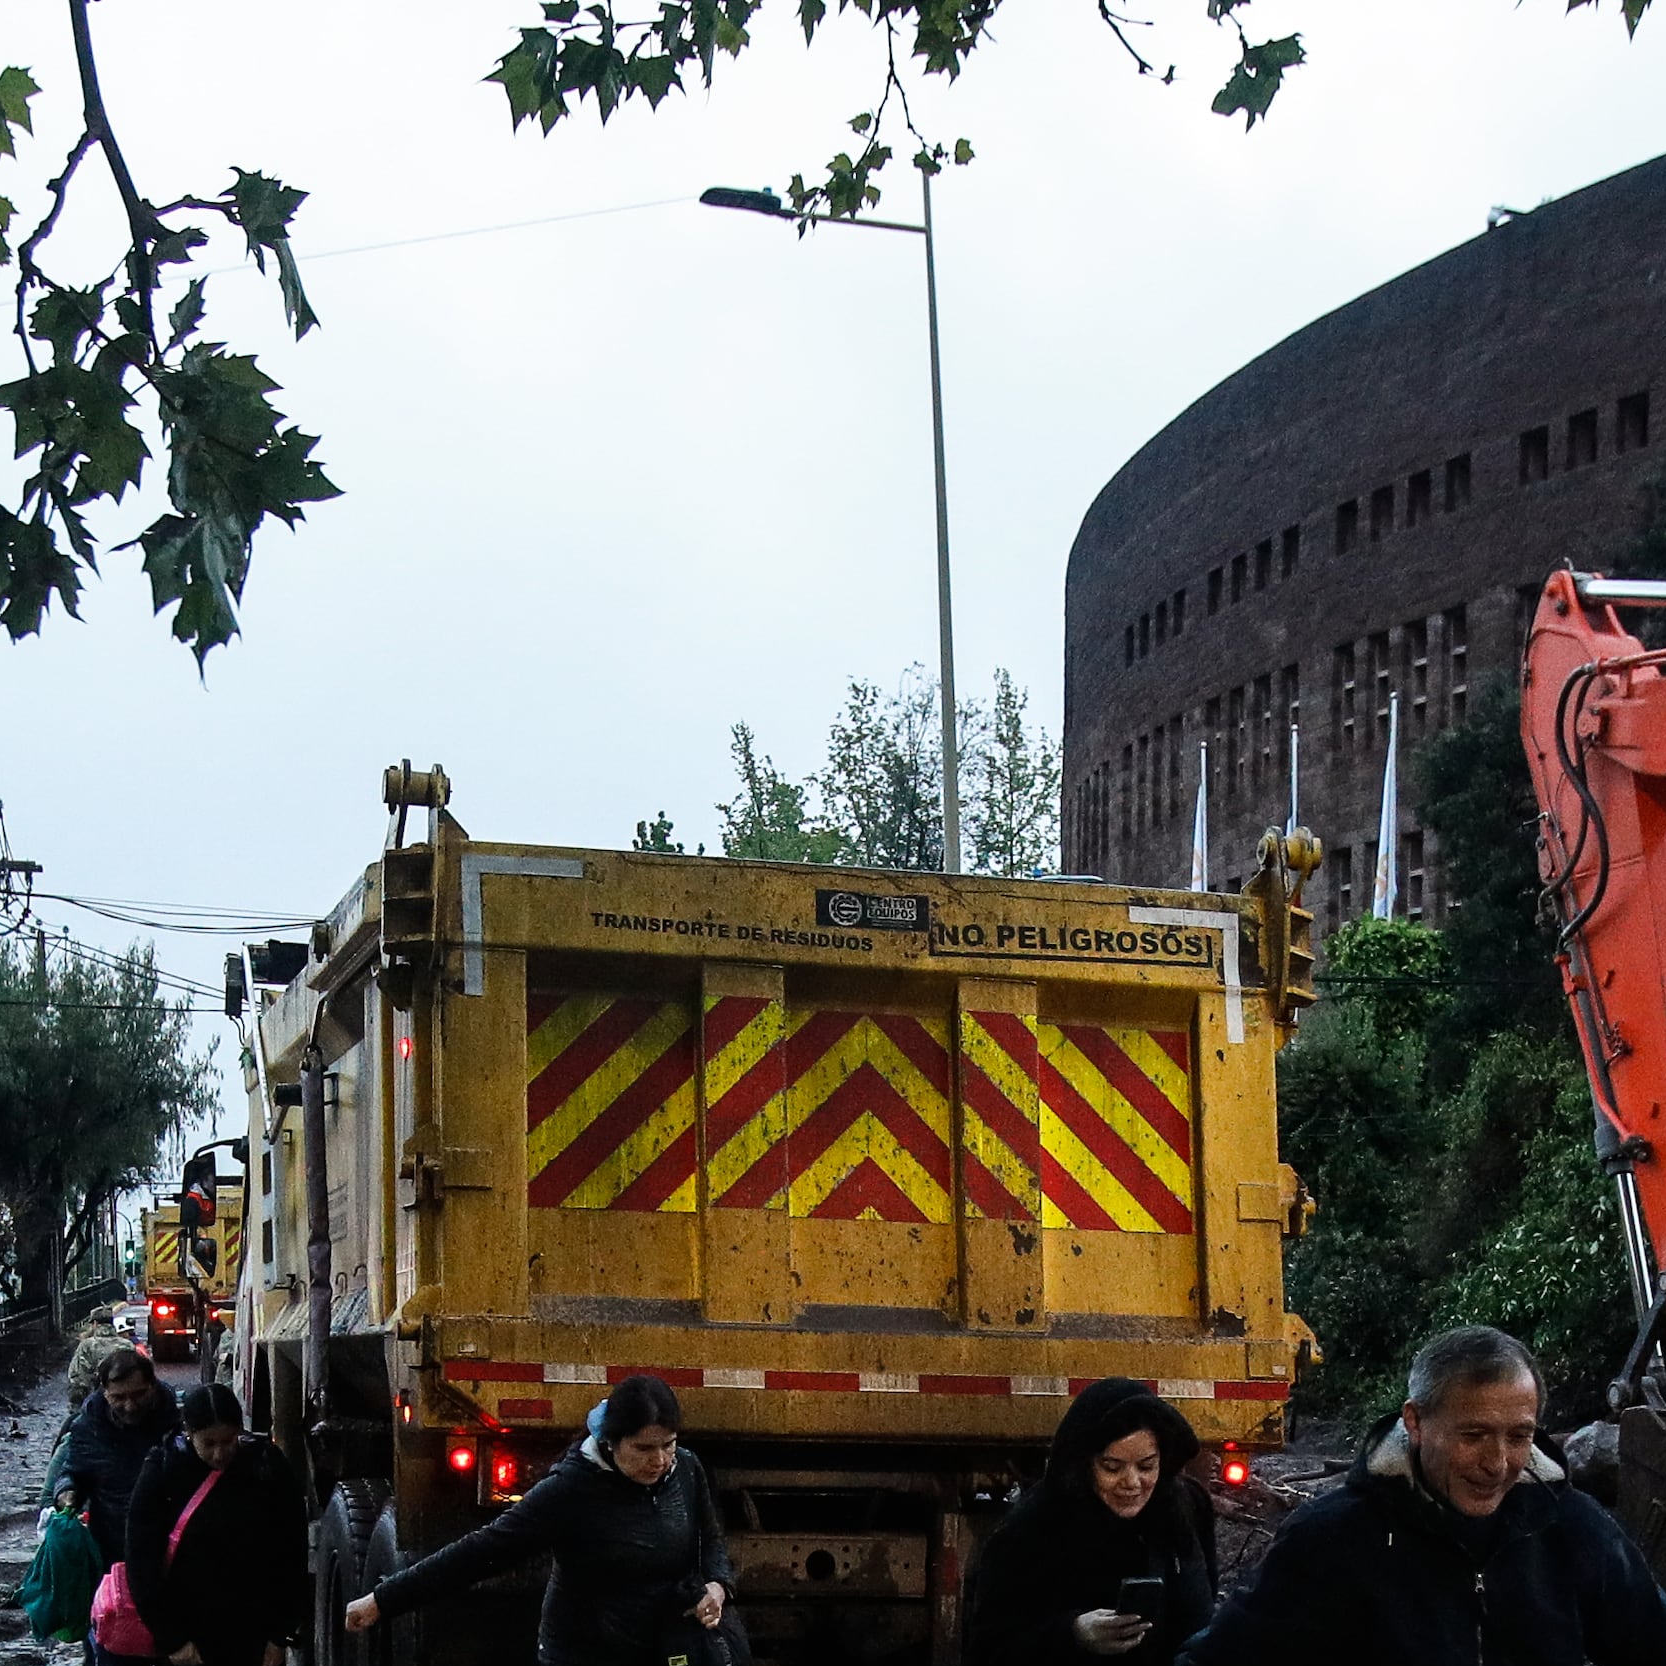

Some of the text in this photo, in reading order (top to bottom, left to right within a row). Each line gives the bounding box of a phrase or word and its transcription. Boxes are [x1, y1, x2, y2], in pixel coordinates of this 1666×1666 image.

[868, 896, 916, 909] CENTRO
[868, 908, 916, 919] EQUIPOS
[590, 912, 1203, 956] TRANSPORTE DE RESIDUOS NO PELIGROSOS
